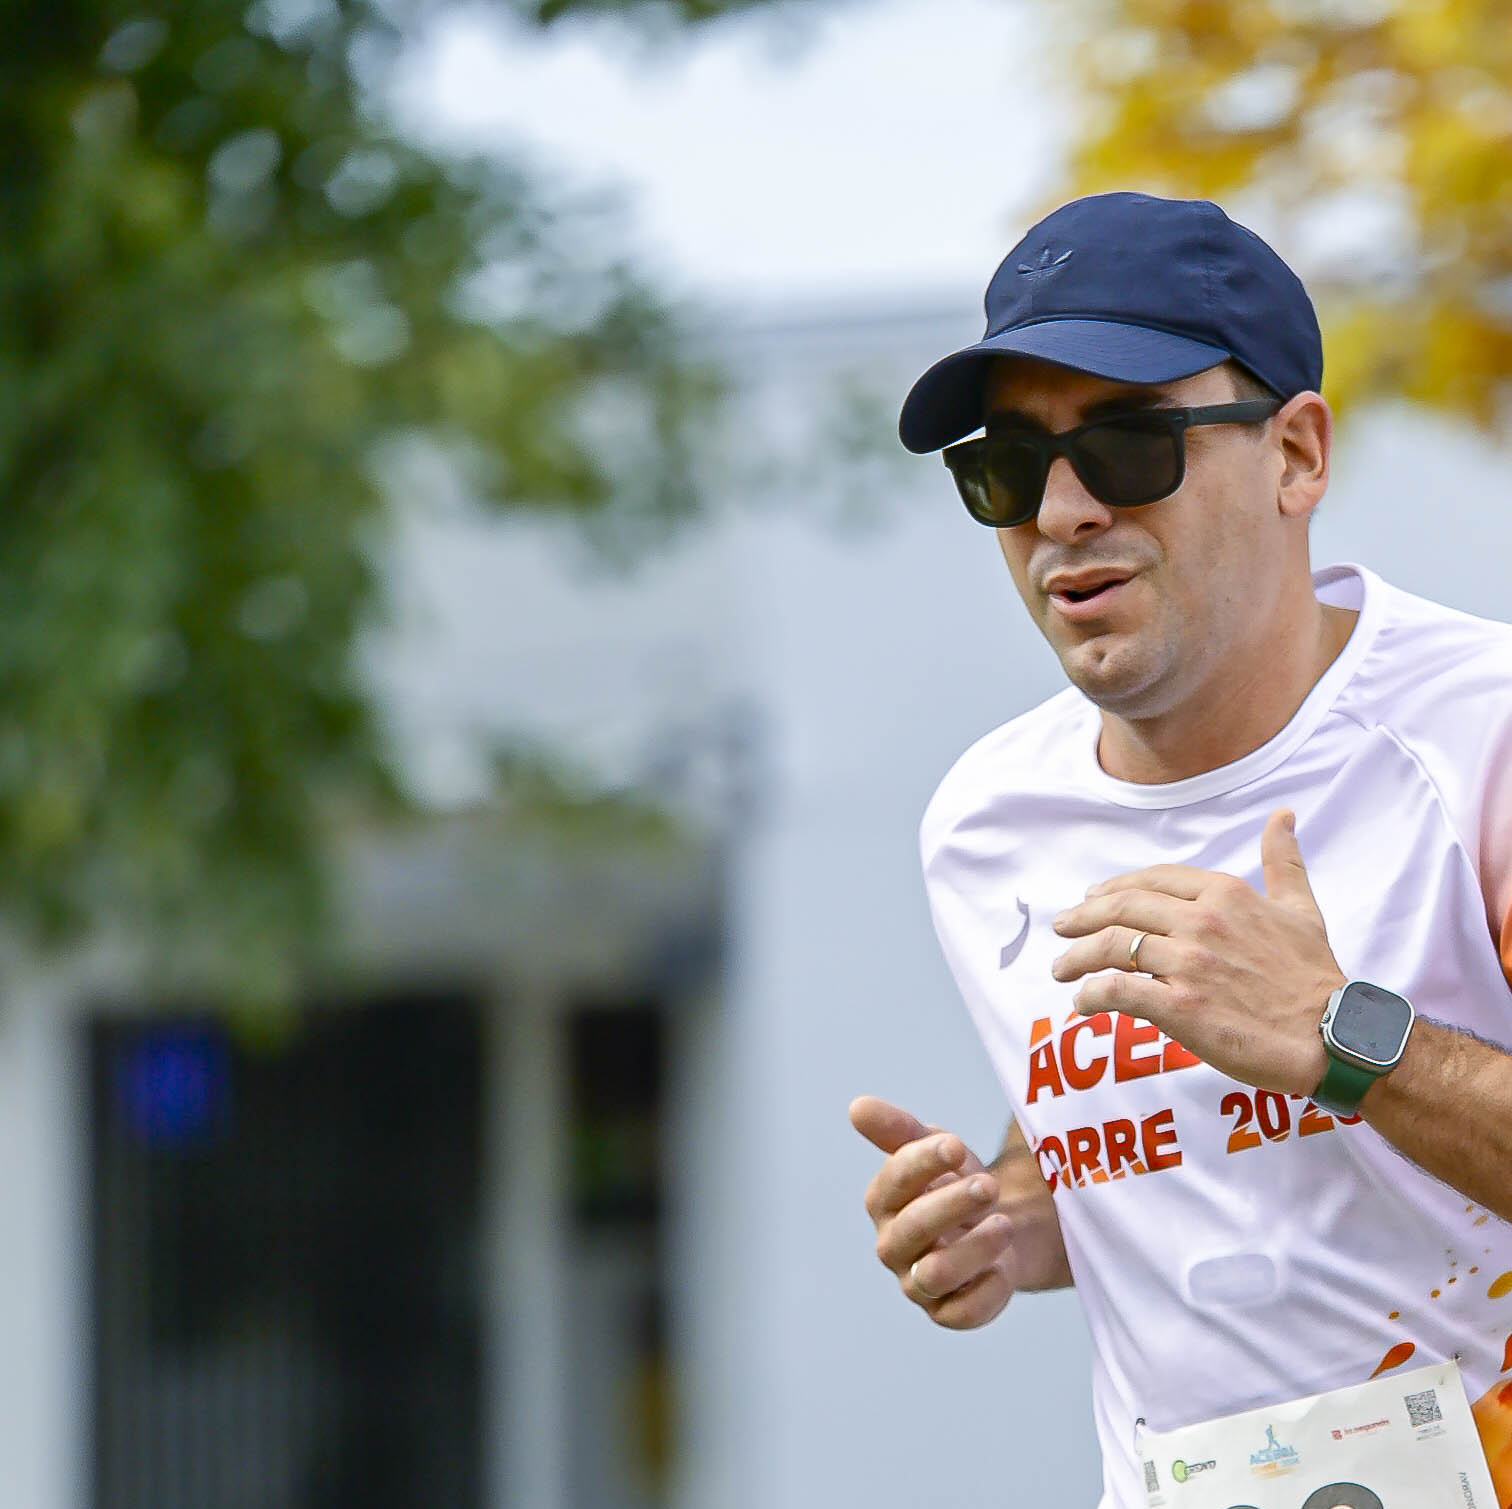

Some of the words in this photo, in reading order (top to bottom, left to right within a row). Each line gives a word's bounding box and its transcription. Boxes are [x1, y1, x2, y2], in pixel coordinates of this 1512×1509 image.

[1026, 1011, 1203, 1105] ACE
[1033, 1108, 1182, 1194] ORRE
[1220, 1091, 1364, 1155] 202
